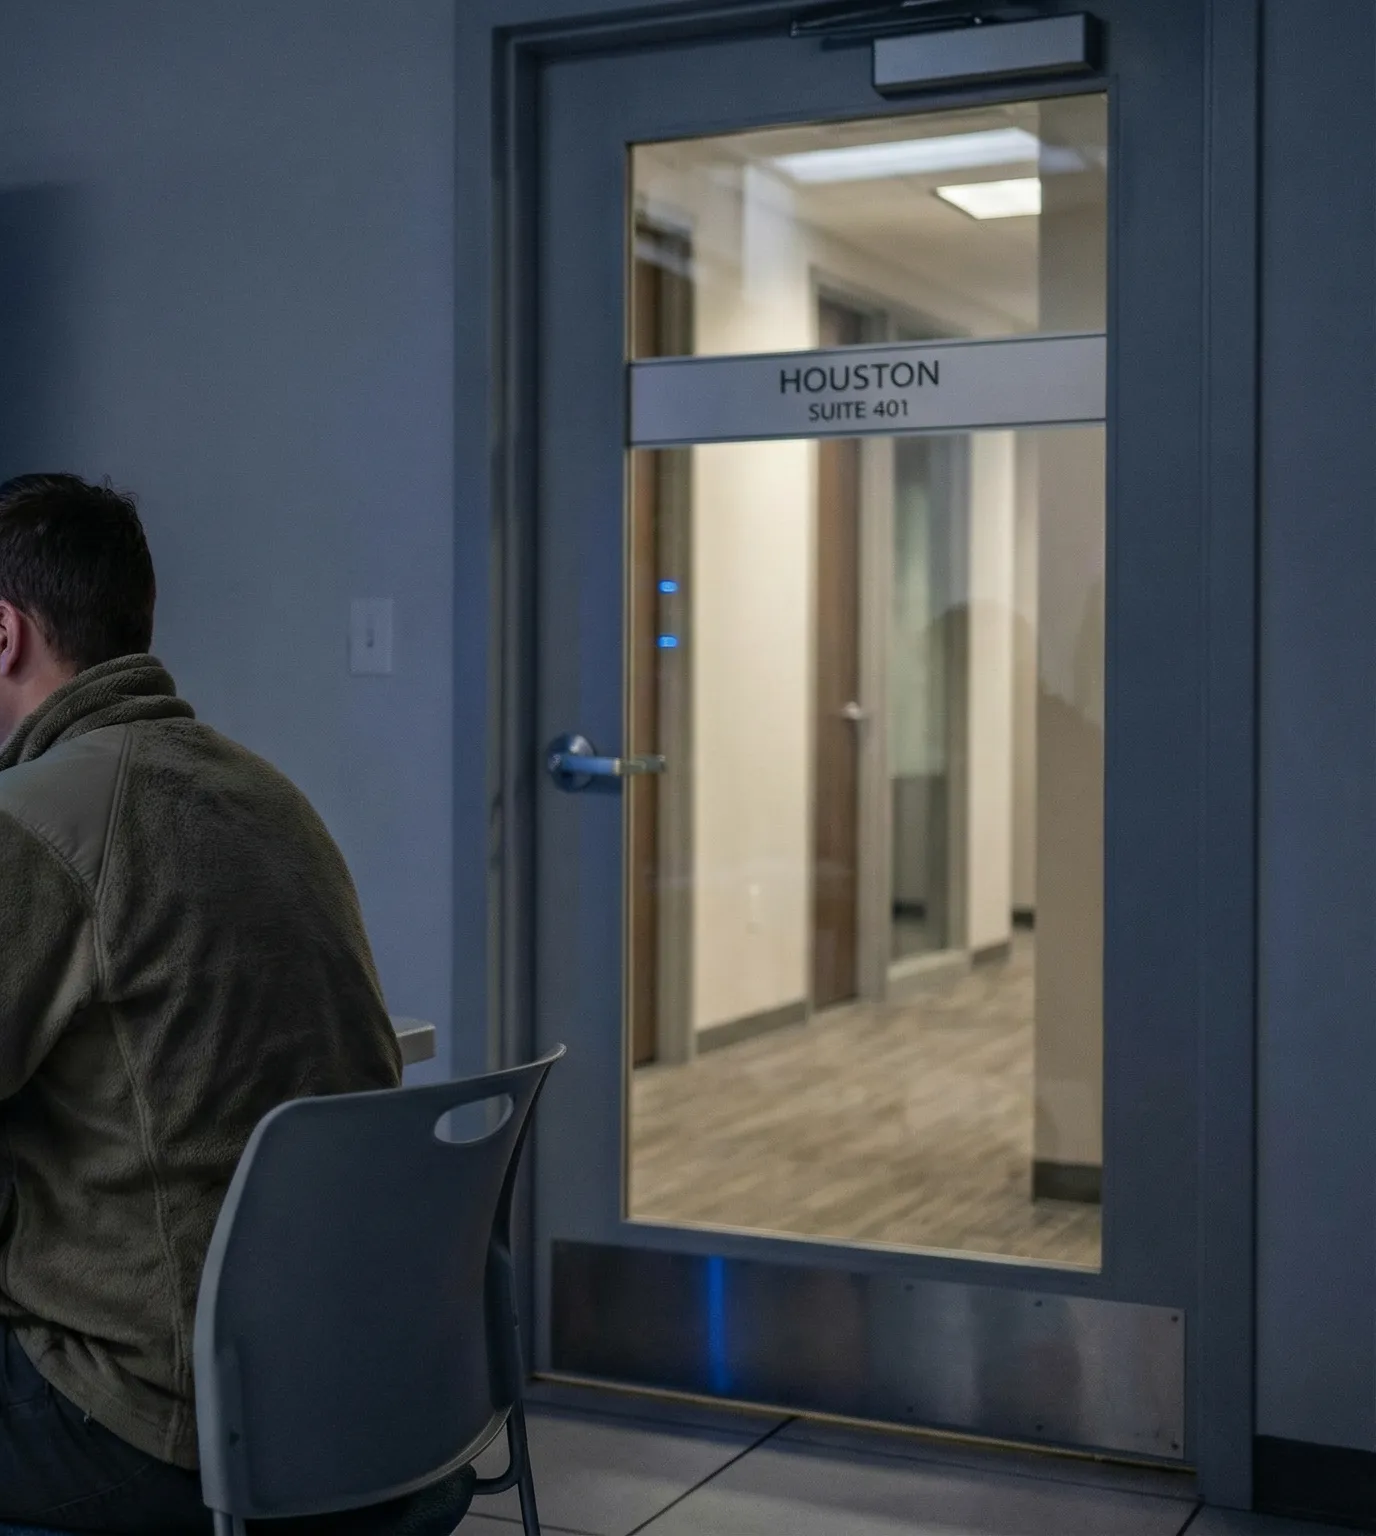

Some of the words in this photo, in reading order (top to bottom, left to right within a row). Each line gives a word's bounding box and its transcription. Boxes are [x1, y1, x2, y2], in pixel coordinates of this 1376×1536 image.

[780, 361, 940, 394] HOUSTON
[809, 401, 866, 421] SUITE
[873, 399, 908, 417] 401
